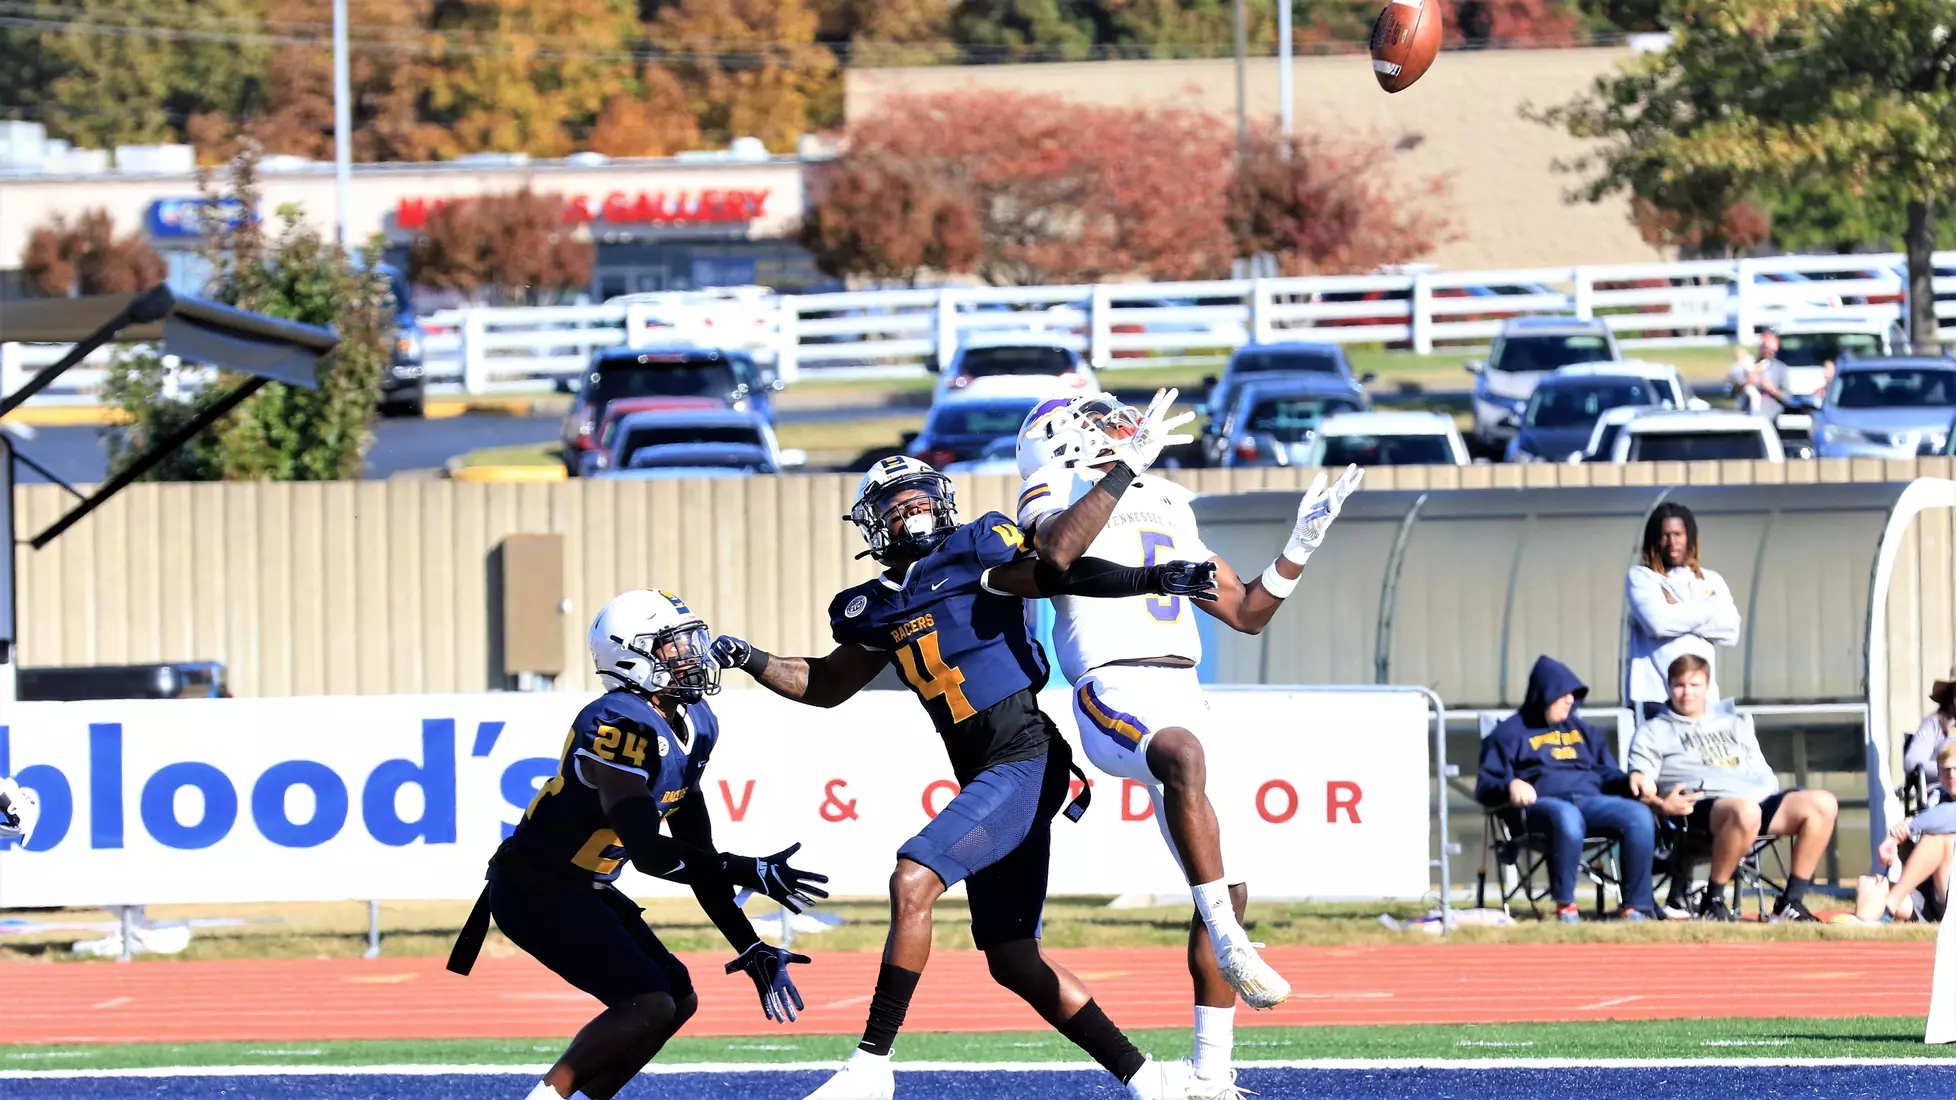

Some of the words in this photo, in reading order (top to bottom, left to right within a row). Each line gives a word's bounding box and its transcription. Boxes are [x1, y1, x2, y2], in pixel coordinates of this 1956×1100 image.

[603, 188, 772, 223] GALLERY
[992, 524, 1030, 553] 4
[1137, 528, 1182, 624] 5
[890, 613, 936, 643] RACERS
[895, 630, 977, 724] 4
[593, 725, 649, 767] 24
[819, 778, 859, 822] &
